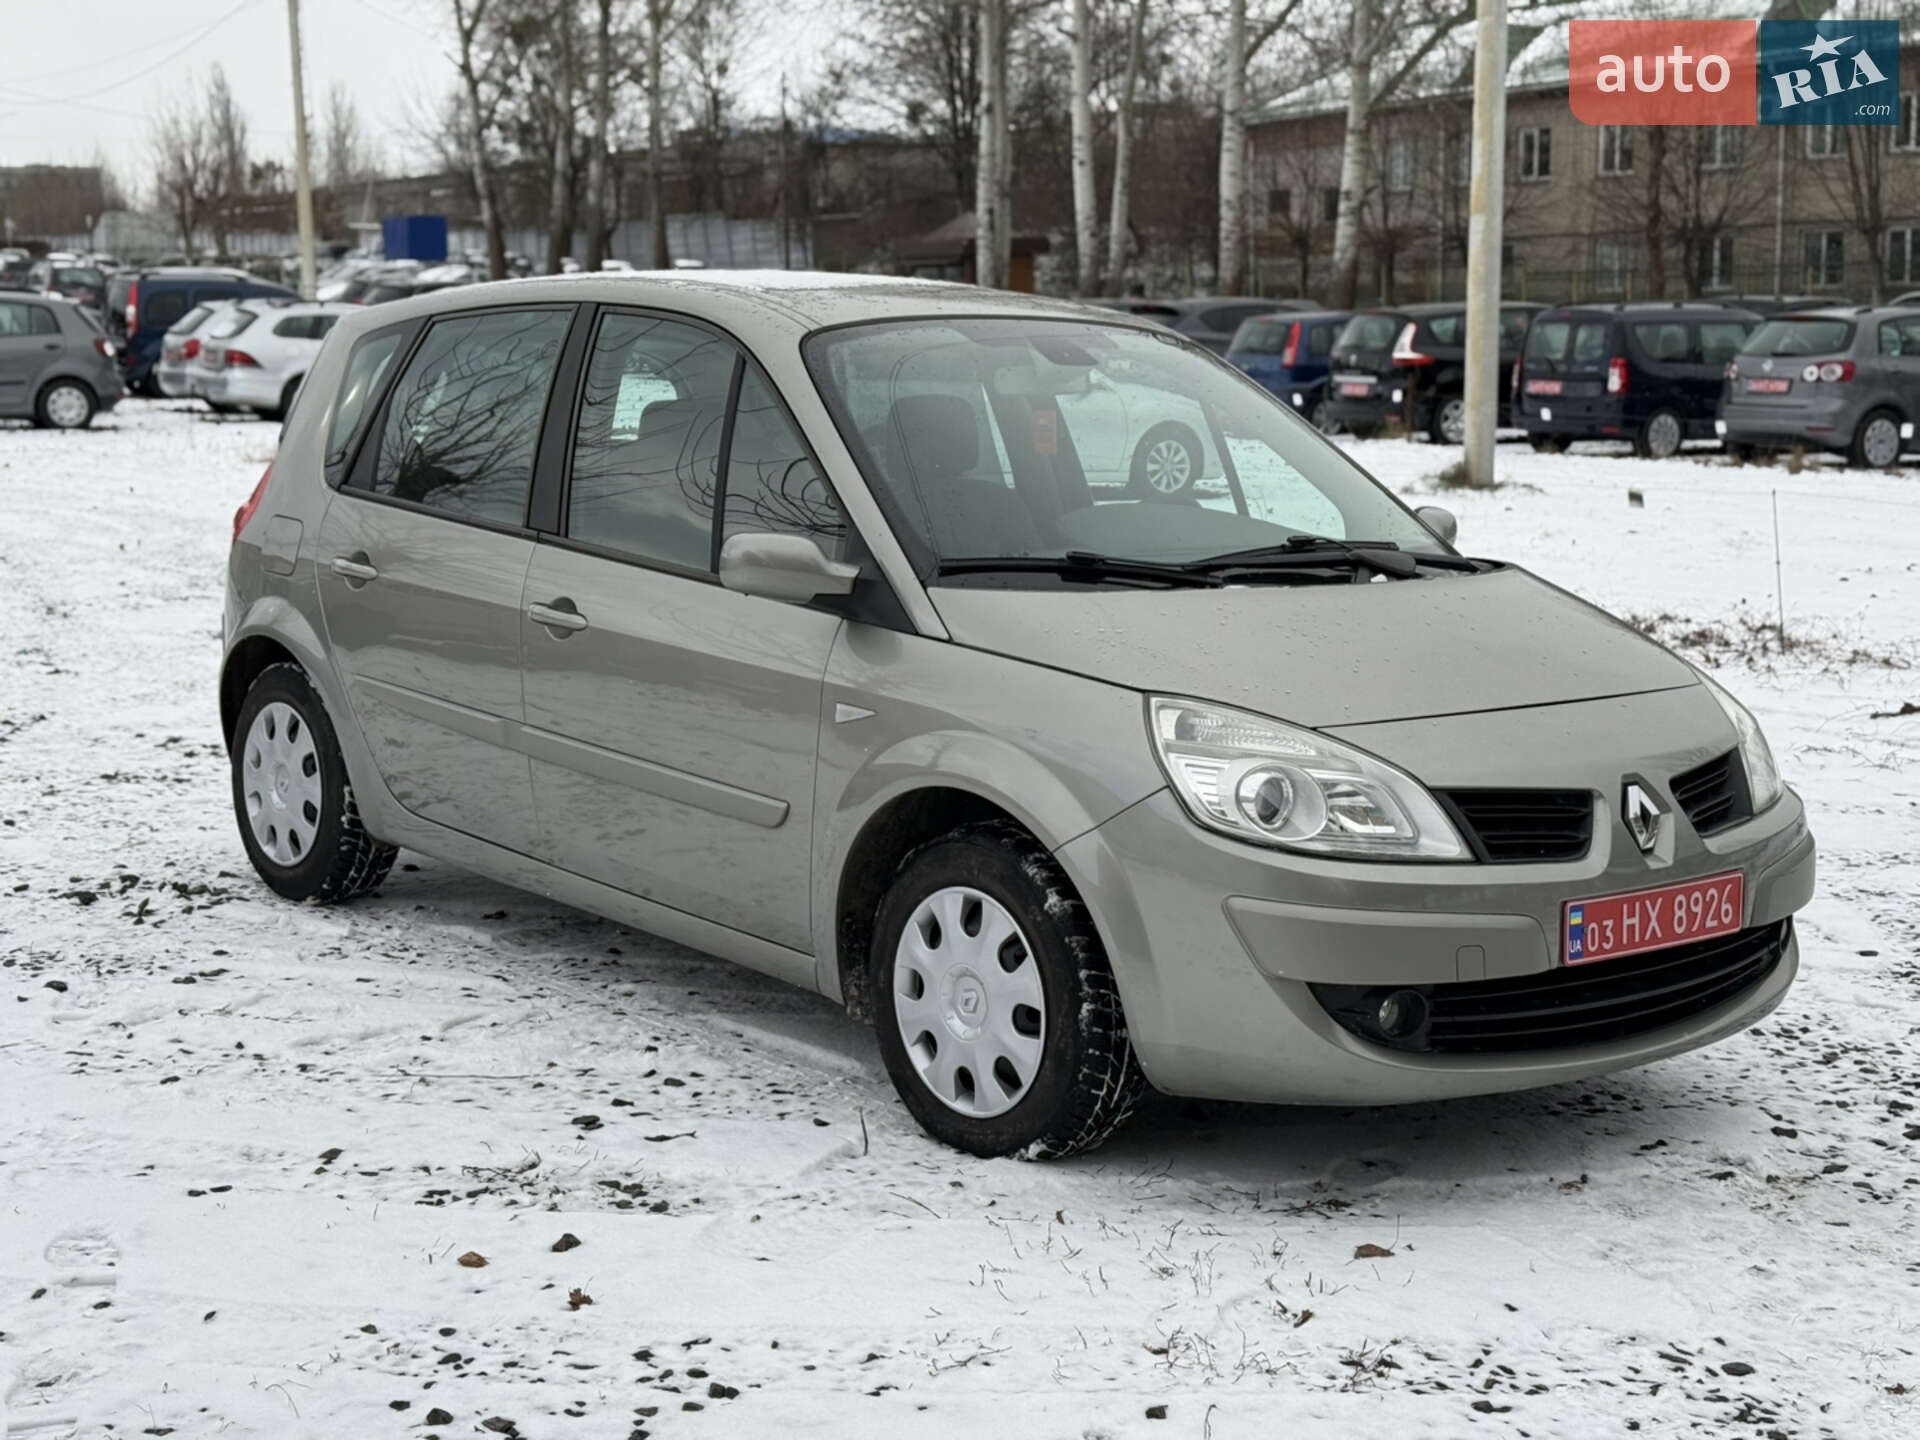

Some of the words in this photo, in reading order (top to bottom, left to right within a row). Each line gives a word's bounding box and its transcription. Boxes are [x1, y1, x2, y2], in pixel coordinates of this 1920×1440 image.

[1587, 919, 1614, 952] 03
[1622, 898, 1663, 945] HX
[1673, 884, 1733, 935] 8926
[1569, 940, 1582, 953] UA
